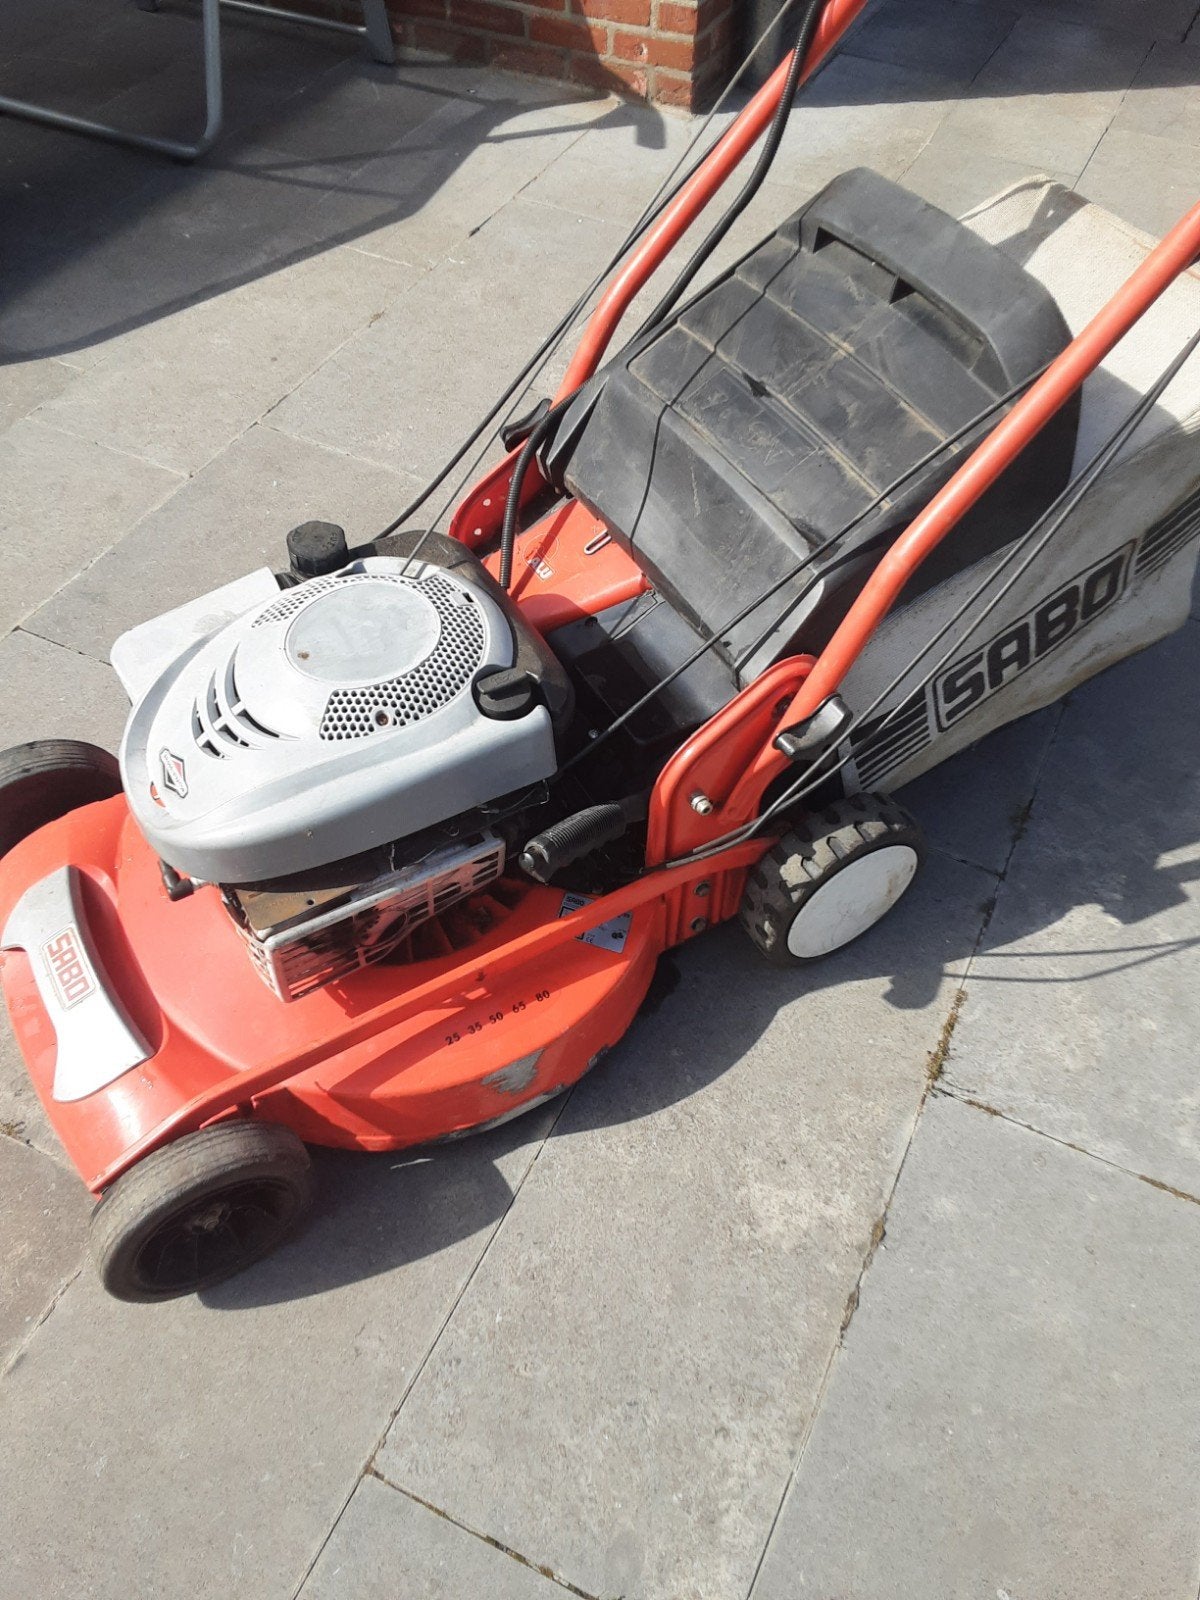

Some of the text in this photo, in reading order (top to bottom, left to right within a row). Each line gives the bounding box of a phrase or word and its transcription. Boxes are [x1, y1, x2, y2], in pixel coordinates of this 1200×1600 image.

[943, 553, 1126, 723] SABO
[47, 932, 90, 1001] SABO
[445, 990, 550, 1045] 25 35 50 65 80
